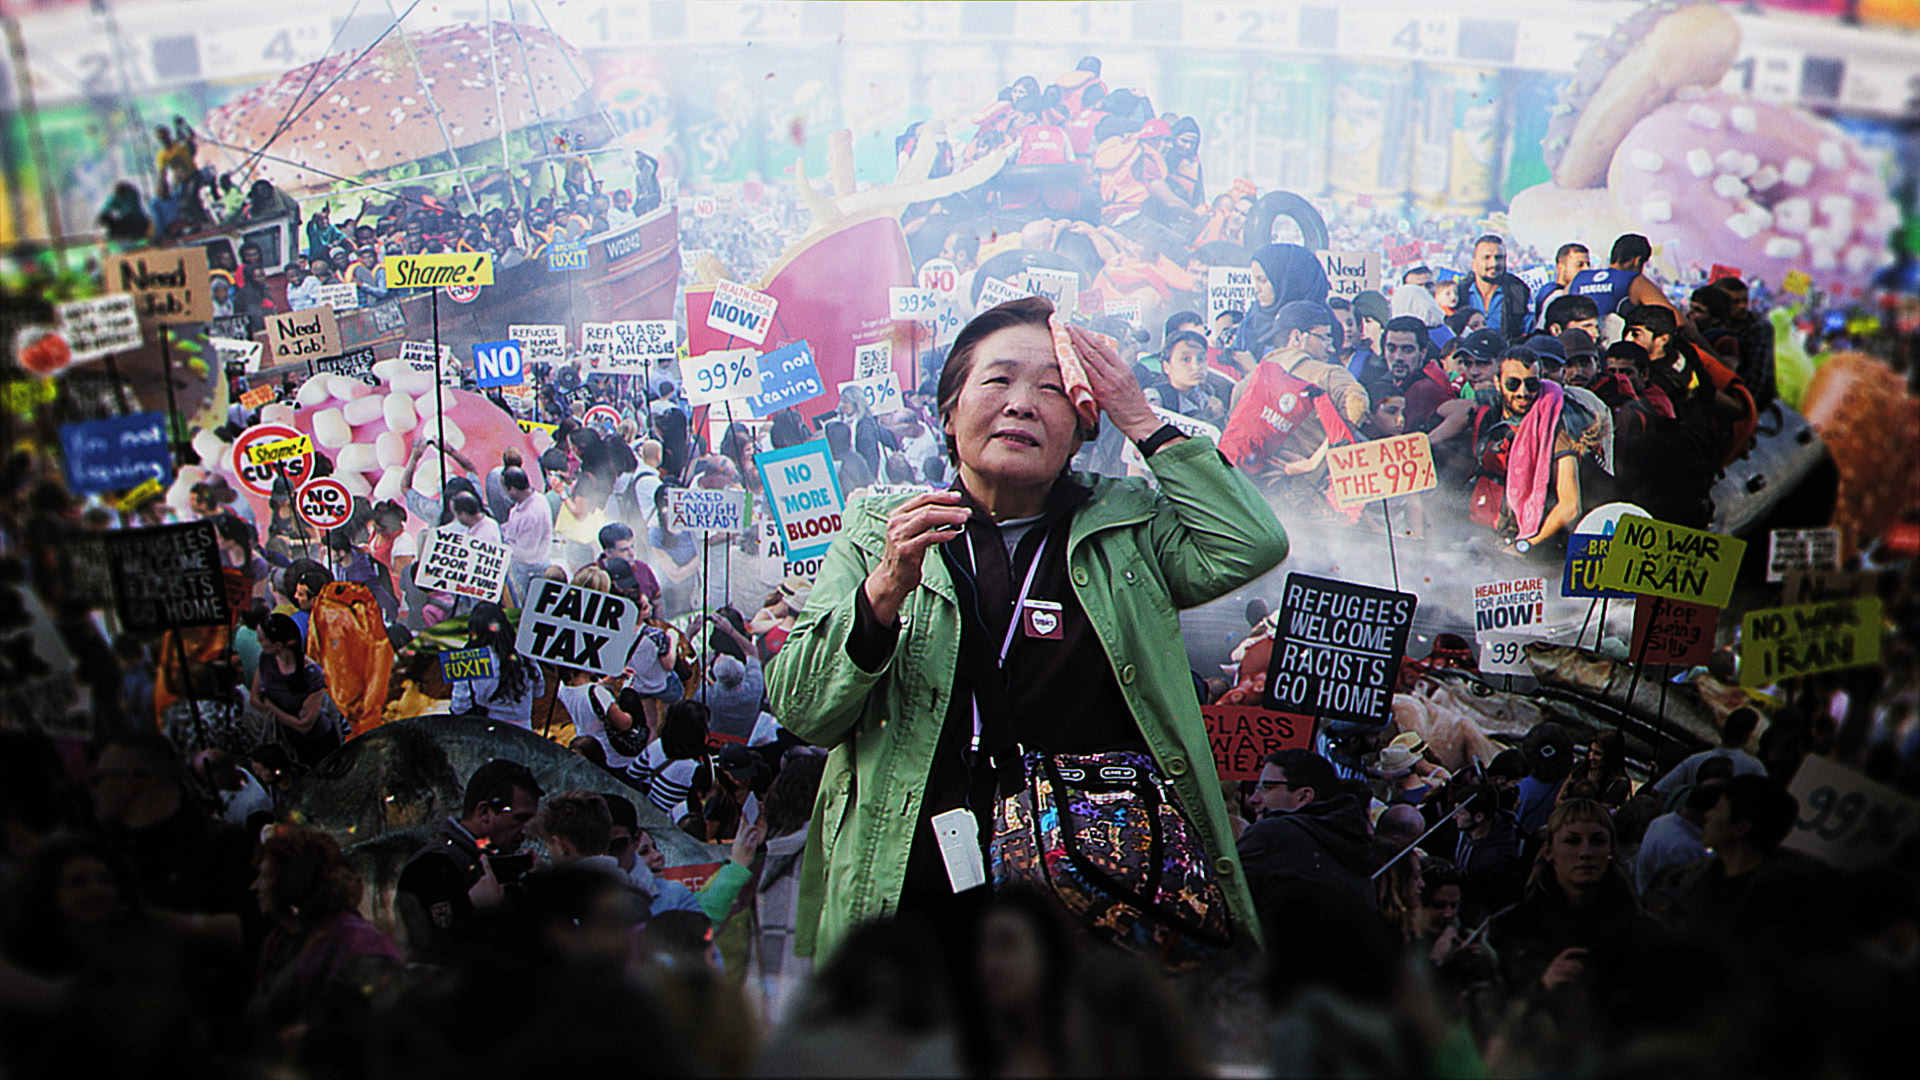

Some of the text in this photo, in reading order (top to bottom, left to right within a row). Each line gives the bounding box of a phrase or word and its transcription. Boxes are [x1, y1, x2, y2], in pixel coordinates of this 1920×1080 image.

[394, 257, 484, 286] Shame!
[548, 250, 588, 268] FUXIT
[1327, 255, 1366, 277] Need
[924, 271, 955, 292] NO
[1227, 272, 1251, 284] NON
[716, 291, 733, 302] FOR
[719, 281, 774, 308] HEALTH CARE
[899, 292, 936, 312] 99%
[276, 314, 321, 340] Need
[711, 300, 768, 334] NOW!
[616, 324, 667, 337] CLASS
[621, 335, 661, 344] WAR
[278, 335, 327, 356] a Job!
[477, 346, 520, 379] NO
[697, 355, 752, 392] 99%
[781, 351, 810, 373] not
[753, 378, 818, 408] leaving
[255, 437, 306, 464] Shame!
[1332, 437, 1423, 470] WE ARE
[242, 459, 305, 482] CUTS
[784, 463, 812, 487] NO
[1336, 460, 1434, 495] THE 99%
[308, 489, 338, 503] NO
[674, 491, 723, 502] TAXED
[674, 502, 736, 516] ENOUGH
[783, 487, 832, 514] MORE
[303, 504, 346, 517] CUTS
[672, 515, 739, 529] ALREADY
[436, 530, 463, 545] WE
[787, 514, 842, 541] BLOOD
[434, 542, 503, 569] FEED THE
[1624, 523, 1656, 550] NO
[1667, 530, 1719, 562] WAR
[429, 553, 500, 579] POOR BUT
[1643, 551, 1699, 569] WITH
[425, 564, 498, 590] WE CAN FUND
[433, 580, 447, 589] A
[1475, 578, 1543, 598] HEALTH CARE
[1623, 559, 1709, 596] IRAN
[162, 598, 224, 622] HOME
[534, 582, 625, 631] FAIR
[1286, 584, 1409, 625] REFUGEES
[1475, 591, 1544, 610] FOR AMERICA
[1476, 602, 1543, 632] NOW!
[1752, 613, 1786, 641] NO
[1290, 610, 1395, 652] WELCOME
[530, 622, 610, 669] TAX
[1764, 633, 1855, 677] IRAN
[444, 658, 490, 679] FUXIT
[1281, 643, 1386, 686] RACISTS
[1273, 672, 1386, 718] GO HOME
[1211, 735, 1282, 754] WAR
